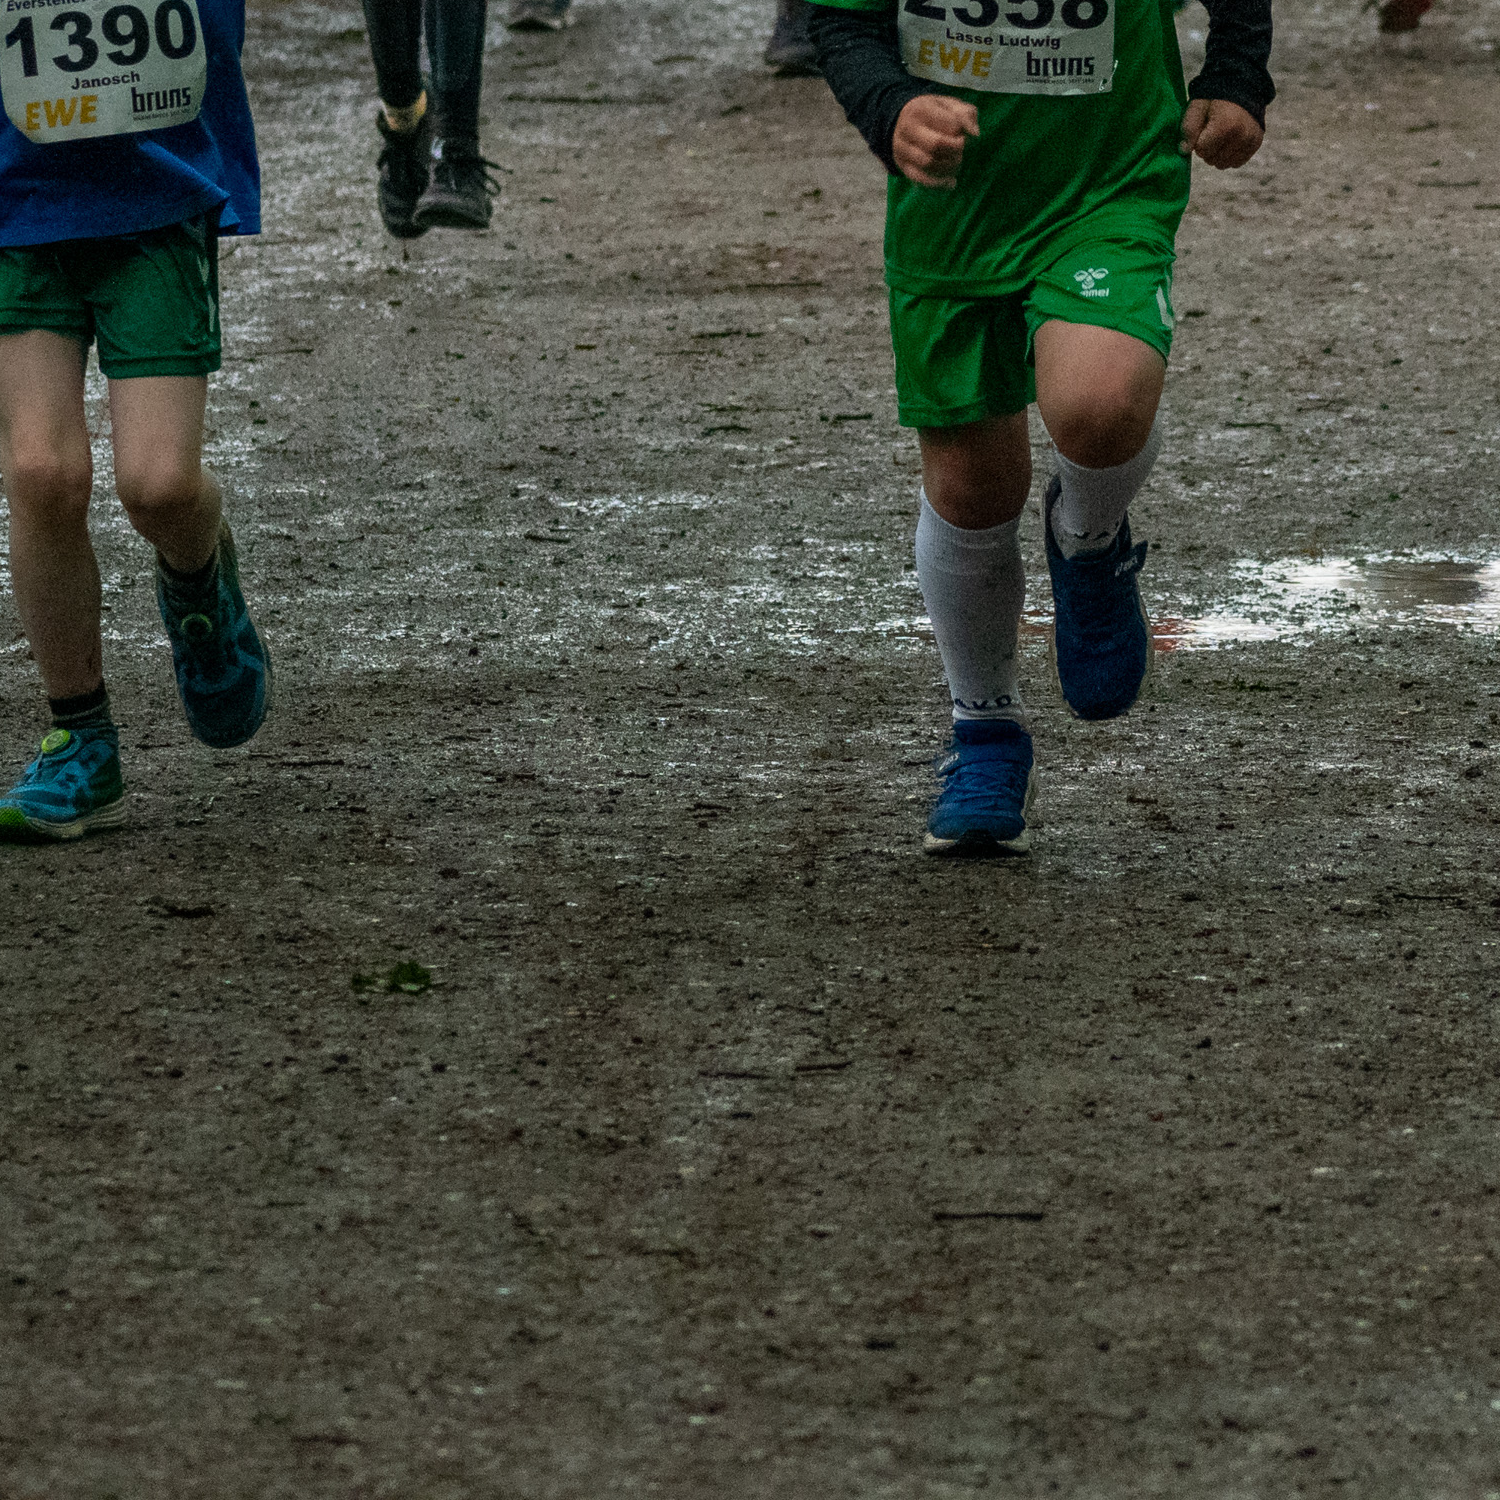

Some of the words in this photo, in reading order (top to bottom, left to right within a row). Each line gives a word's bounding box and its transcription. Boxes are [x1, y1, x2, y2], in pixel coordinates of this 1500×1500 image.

[946, 28, 994, 46] Lasse
[999, 35, 1062, 50] Ludwig
[916, 38, 993, 78] EWE
[1026, 51, 1095, 77] bruns
[71, 71, 141, 90] Janosch
[26, 95, 98, 131] EWE
[131, 86, 191, 113] bruns
